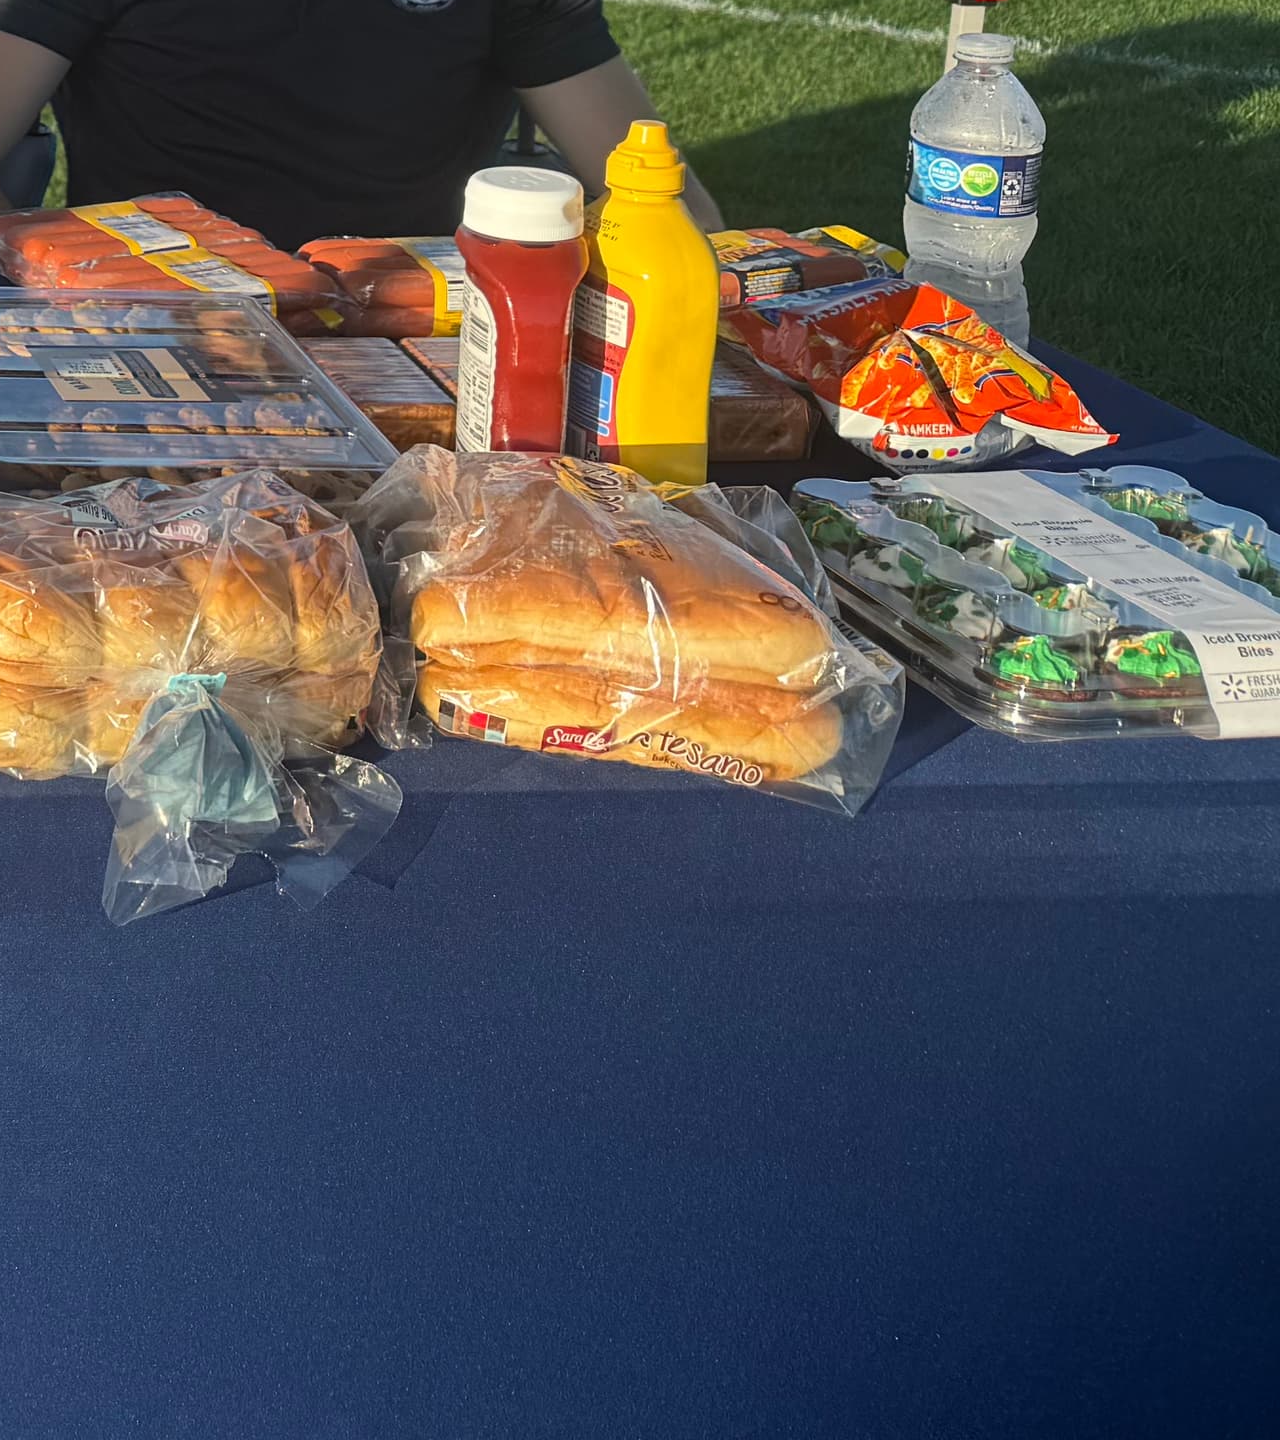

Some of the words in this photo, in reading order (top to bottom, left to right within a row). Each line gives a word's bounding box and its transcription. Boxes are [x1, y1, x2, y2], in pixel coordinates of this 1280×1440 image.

[796, 292, 880, 327] MASALA
[1203, 633, 1234, 646] Iced
[1237, 645, 1275, 659] Bites
[1246, 674, 1280, 687] FRESH
[545, 728, 584, 747] Sara
